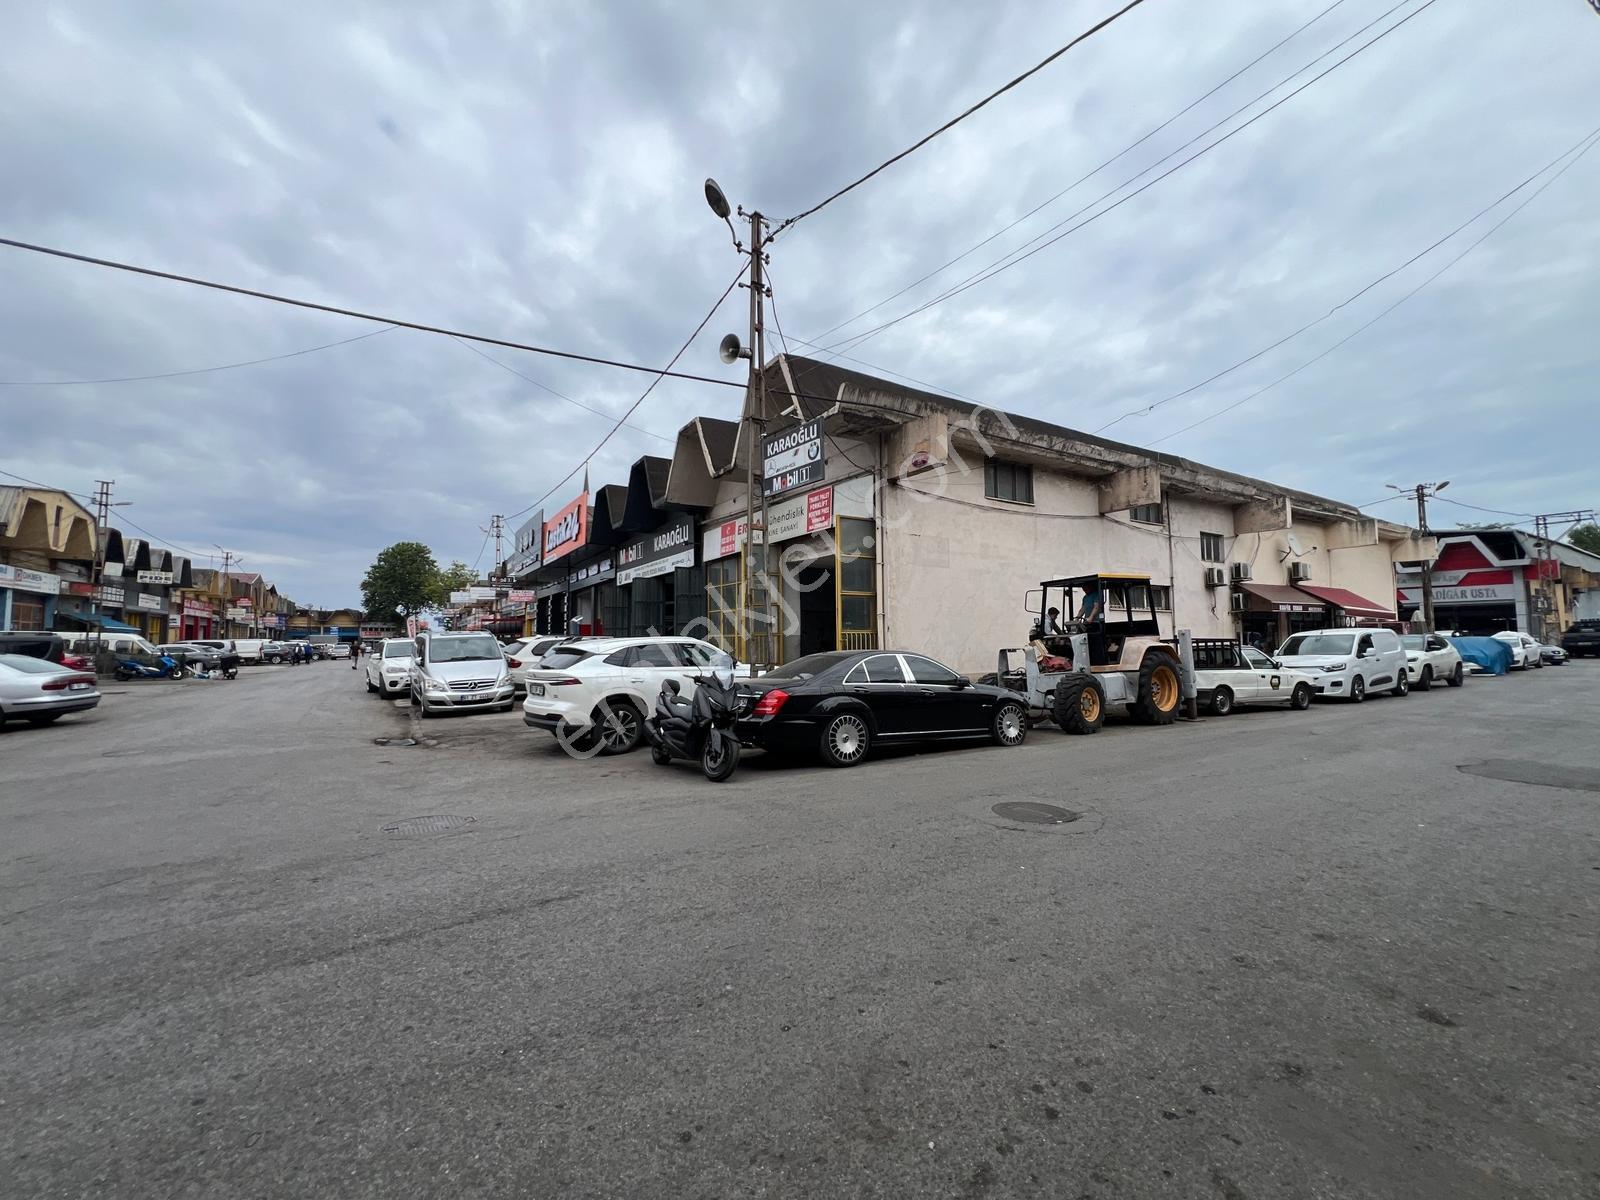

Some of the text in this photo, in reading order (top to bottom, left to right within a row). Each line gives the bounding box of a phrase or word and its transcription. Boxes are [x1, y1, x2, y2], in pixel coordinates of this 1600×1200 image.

[767, 424, 817, 457] KARAOĞLU
[772, 470, 799, 492] Mobil
[653, 524, 689, 552] KARAOĞLU
[619, 544, 637, 565] Mobil
[1431, 588, 1497, 600] ADİGAR USTA
